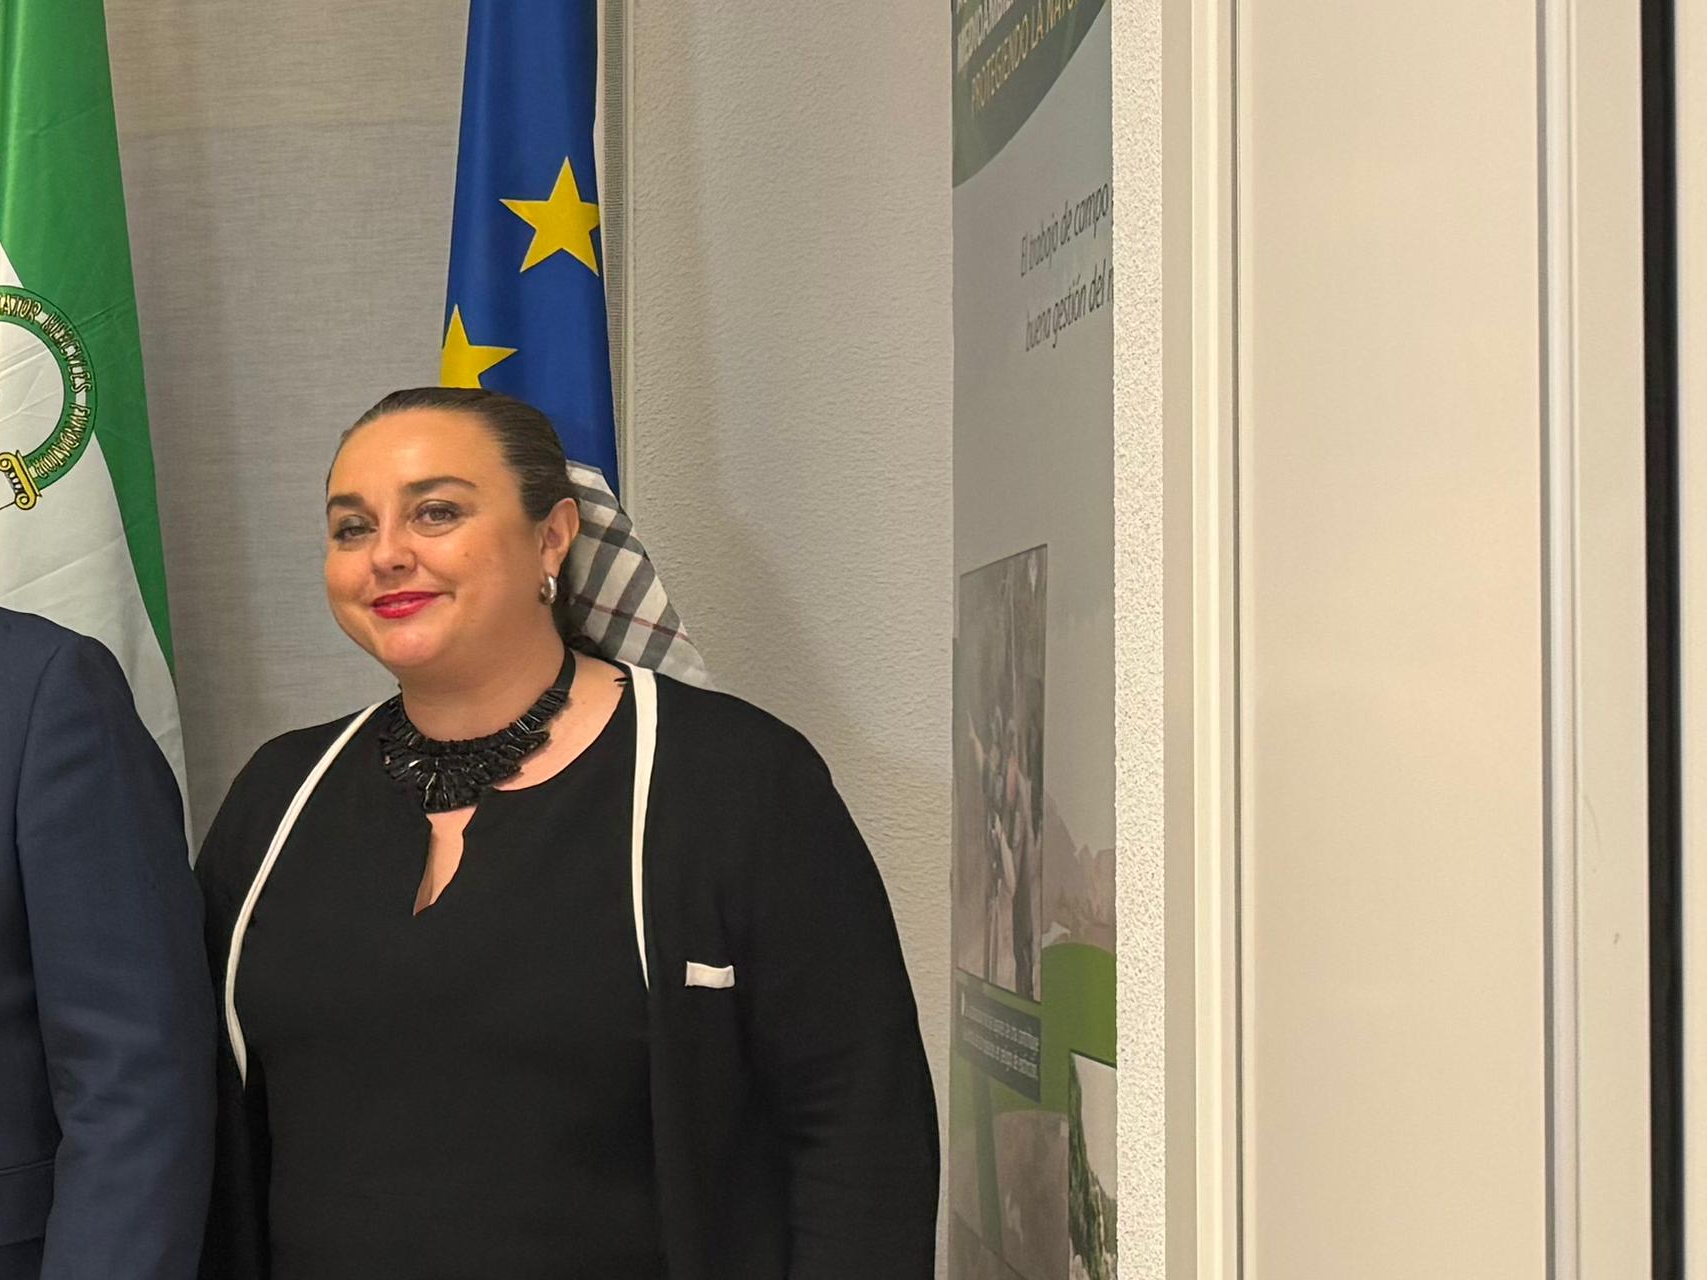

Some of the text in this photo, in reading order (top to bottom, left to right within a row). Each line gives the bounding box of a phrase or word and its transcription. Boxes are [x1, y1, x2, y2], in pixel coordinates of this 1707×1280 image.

[1060, 200, 1072, 246] de
[1074, 182, 1110, 239] campo
[1053, 273, 1087, 349] gestión
[1089, 258, 1107, 313] del
